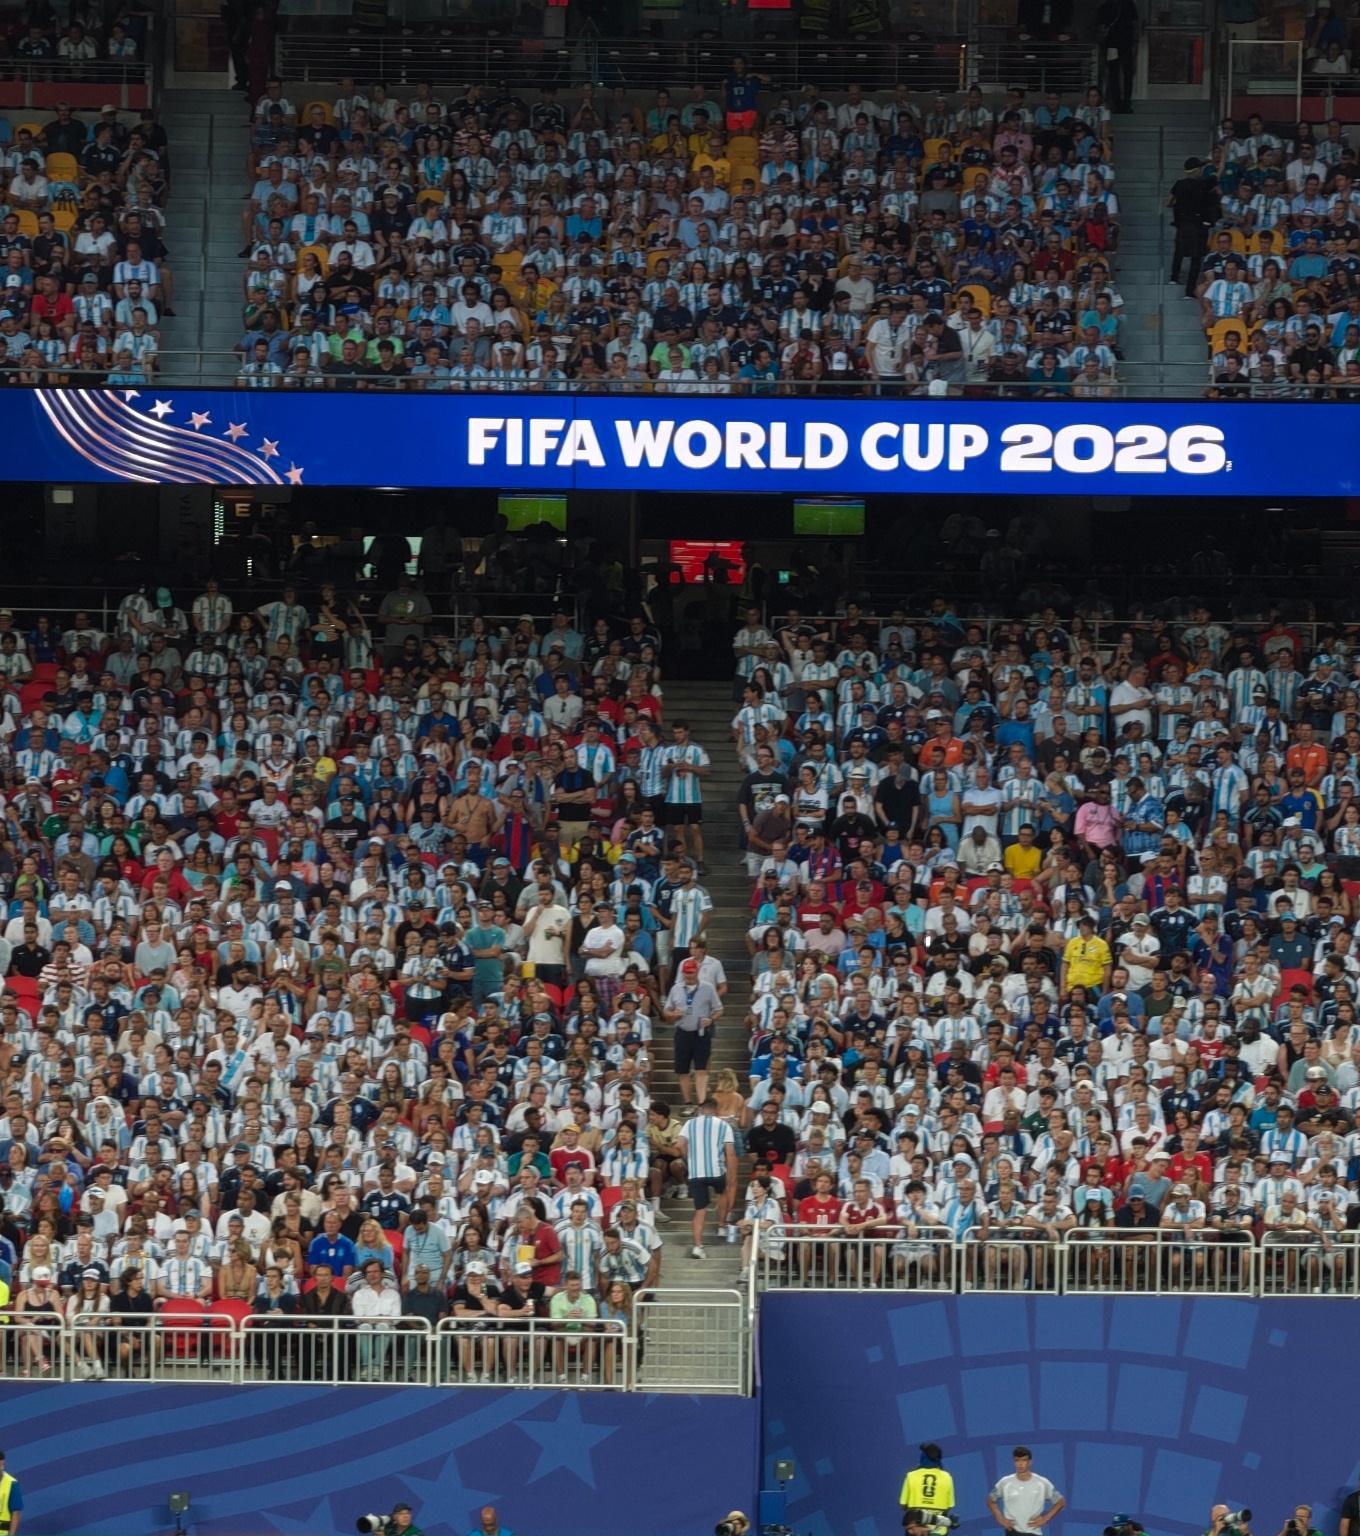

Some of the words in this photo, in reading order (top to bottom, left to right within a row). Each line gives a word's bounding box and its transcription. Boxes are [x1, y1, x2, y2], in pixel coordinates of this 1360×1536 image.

[467, 417, 606, 468] FIFA
[614, 419, 849, 470] WORLD
[860, 421, 989, 472] CUP
[1000, 424, 1226, 474] 2026
